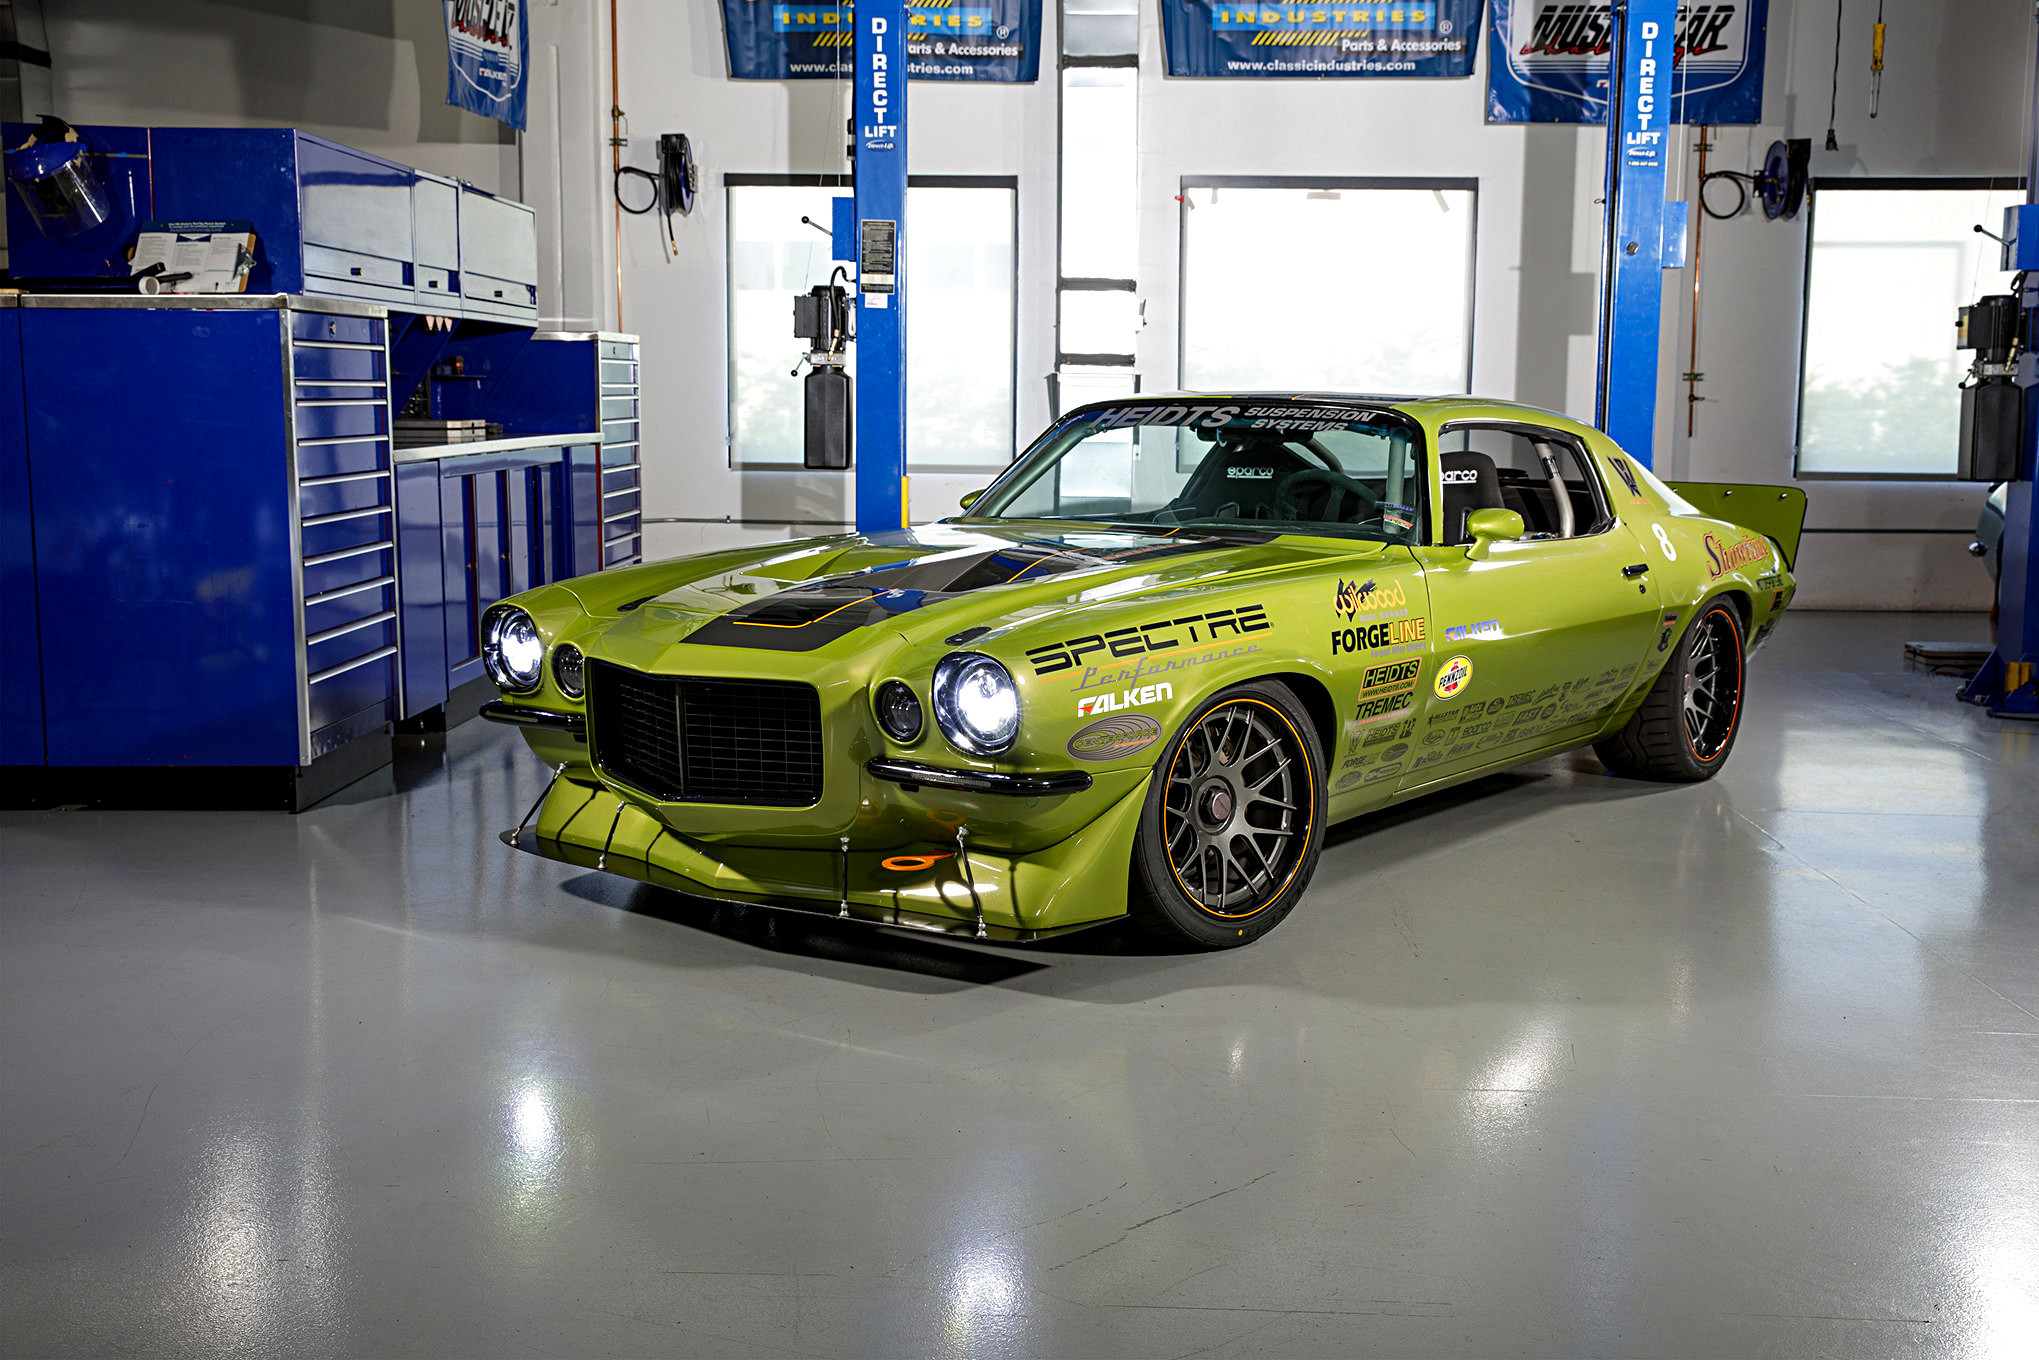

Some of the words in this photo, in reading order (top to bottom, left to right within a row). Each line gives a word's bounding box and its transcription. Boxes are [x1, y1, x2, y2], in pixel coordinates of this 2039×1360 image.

[782, 12, 983, 27] INDRIES
[1221, 10, 1426, 23] INDUSTRIES
[908, 43, 932, 55] arts
[934, 42, 946, 55] &
[948, 43, 1018, 56] Accessories
[1341, 39, 1373, 52] Parts
[1377, 39, 1388, 52] &
[1391, 38, 1461, 52] Accessories
[871, 17, 888, 124] DIRECT
[1227, 60, 1416, 71] www.classicindustries.com
[1637, 22, 1659, 131] DIRECT
[864, 125, 897, 138] LIFT
[1626, 132, 1661, 145] LIFT
[1090, 405, 1241, 428] HEIDTS
[1244, 407, 1377, 423] SUSPENSION
[1250, 418, 1350, 432] SYSTEMS
[1226, 466, 1275, 479] sparco
[1651, 523, 1677, 562] 8
[1359, 612, 1378, 623] DISC
[1379, 608, 1409, 620] BRAKES
[1025, 603, 1271, 676] SPECTRE
[1331, 617, 1427, 656] FORGELINE
[1444, 619, 1502, 643] FALKEN
[1070, 644, 1264, 693] Performance
[1363, 661, 1419, 688] HEIDTS
[1438, 665, 1469, 690] PENNZOIL
[1076, 681, 1174, 718] FALKEN
[1355, 691, 1414, 720] TREMEC
[1076, 727, 1158, 748] CENTERFORCE
